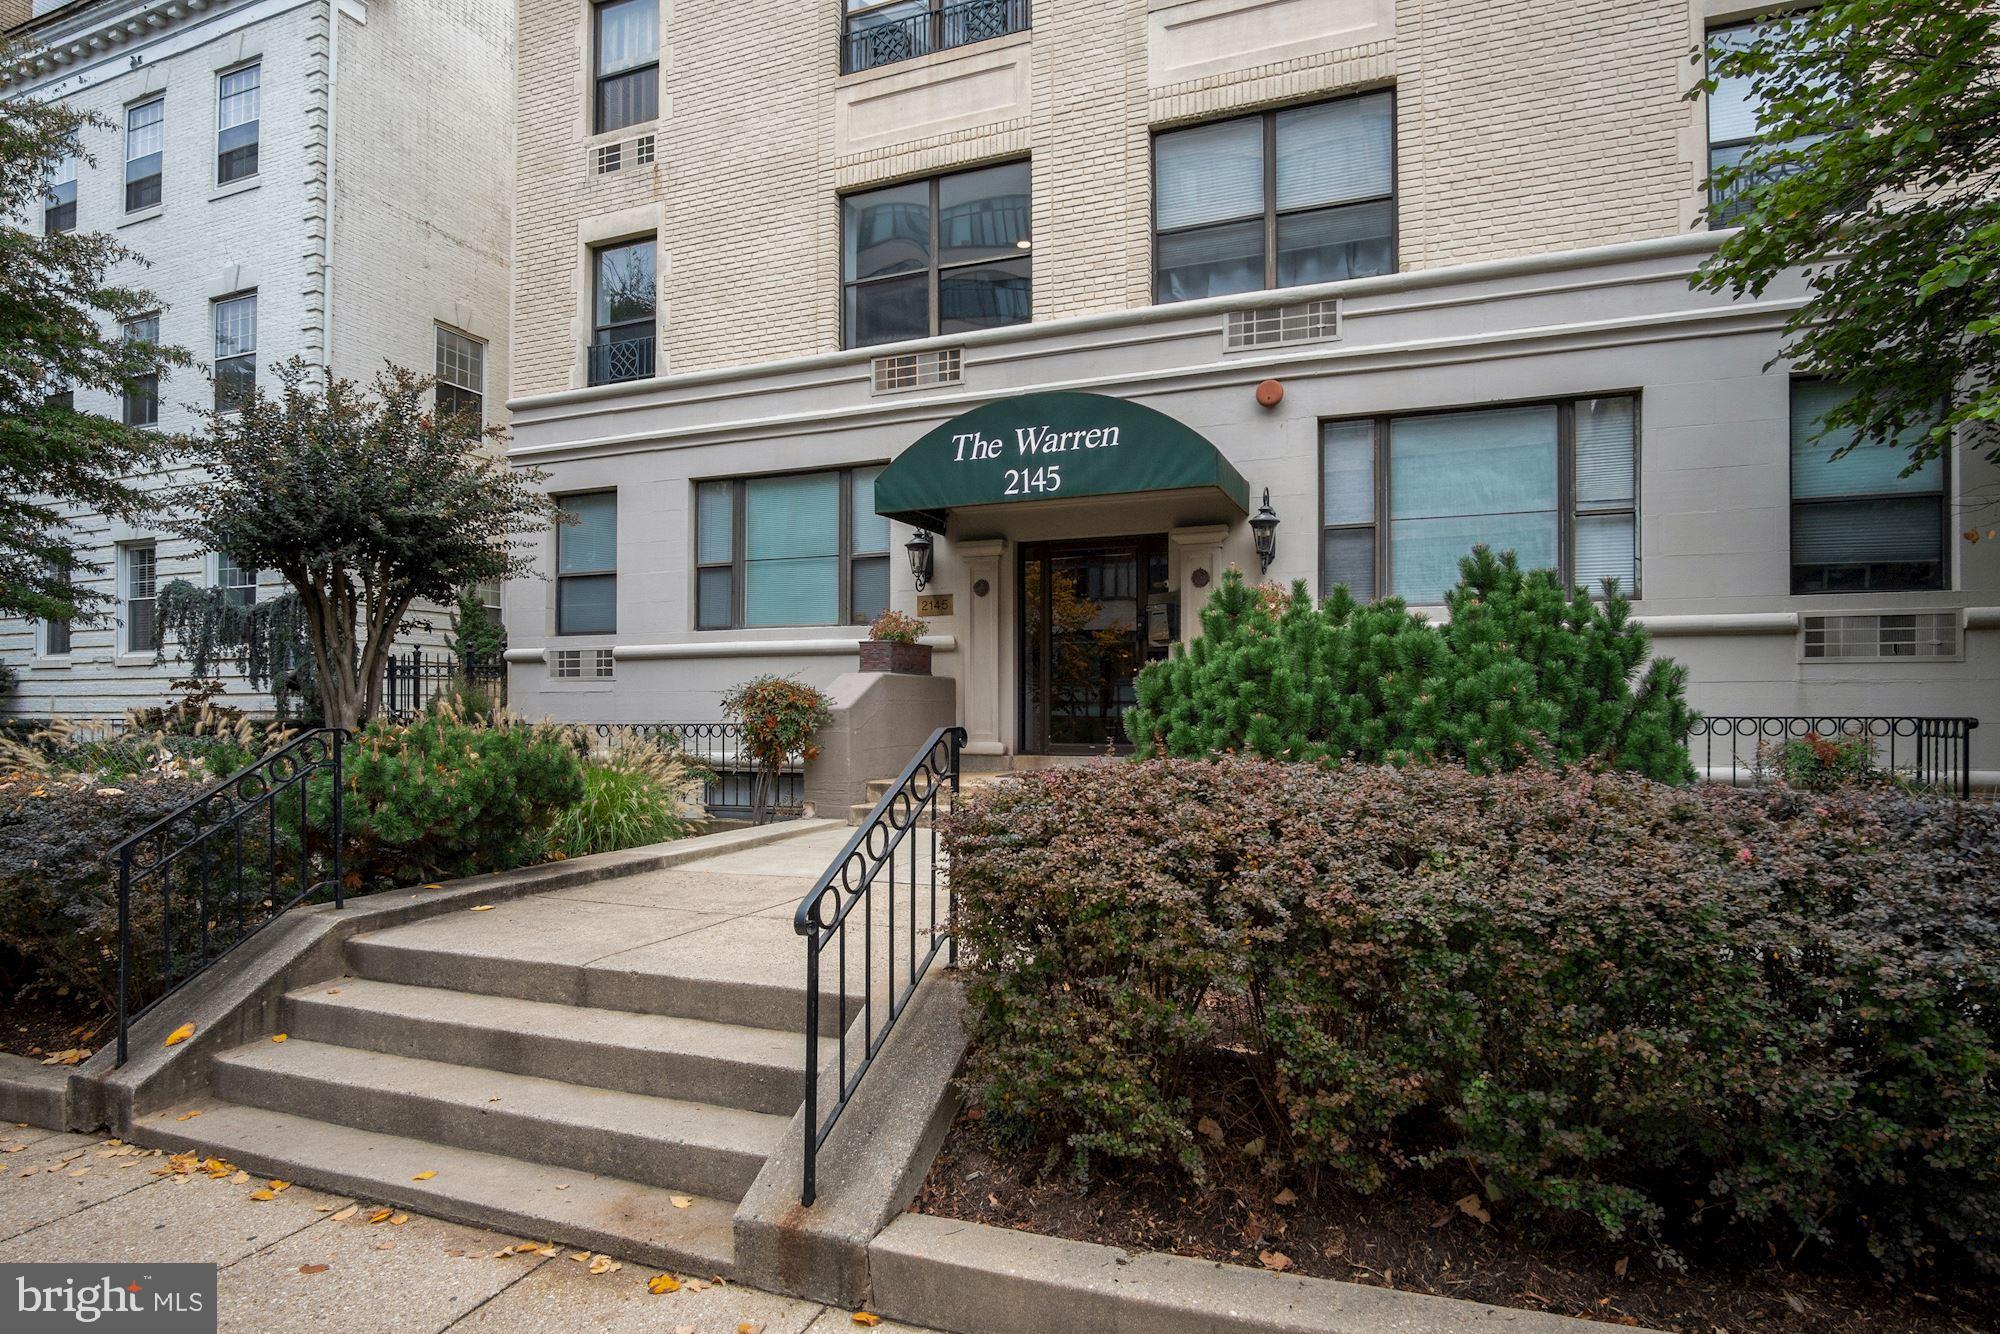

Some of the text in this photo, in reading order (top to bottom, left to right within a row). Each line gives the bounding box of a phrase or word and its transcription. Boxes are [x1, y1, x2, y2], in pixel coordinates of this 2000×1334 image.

[951, 425, 1120, 462] The Warren
[1003, 466, 1061, 496] 2145
[920, 599, 949, 611] 2145
